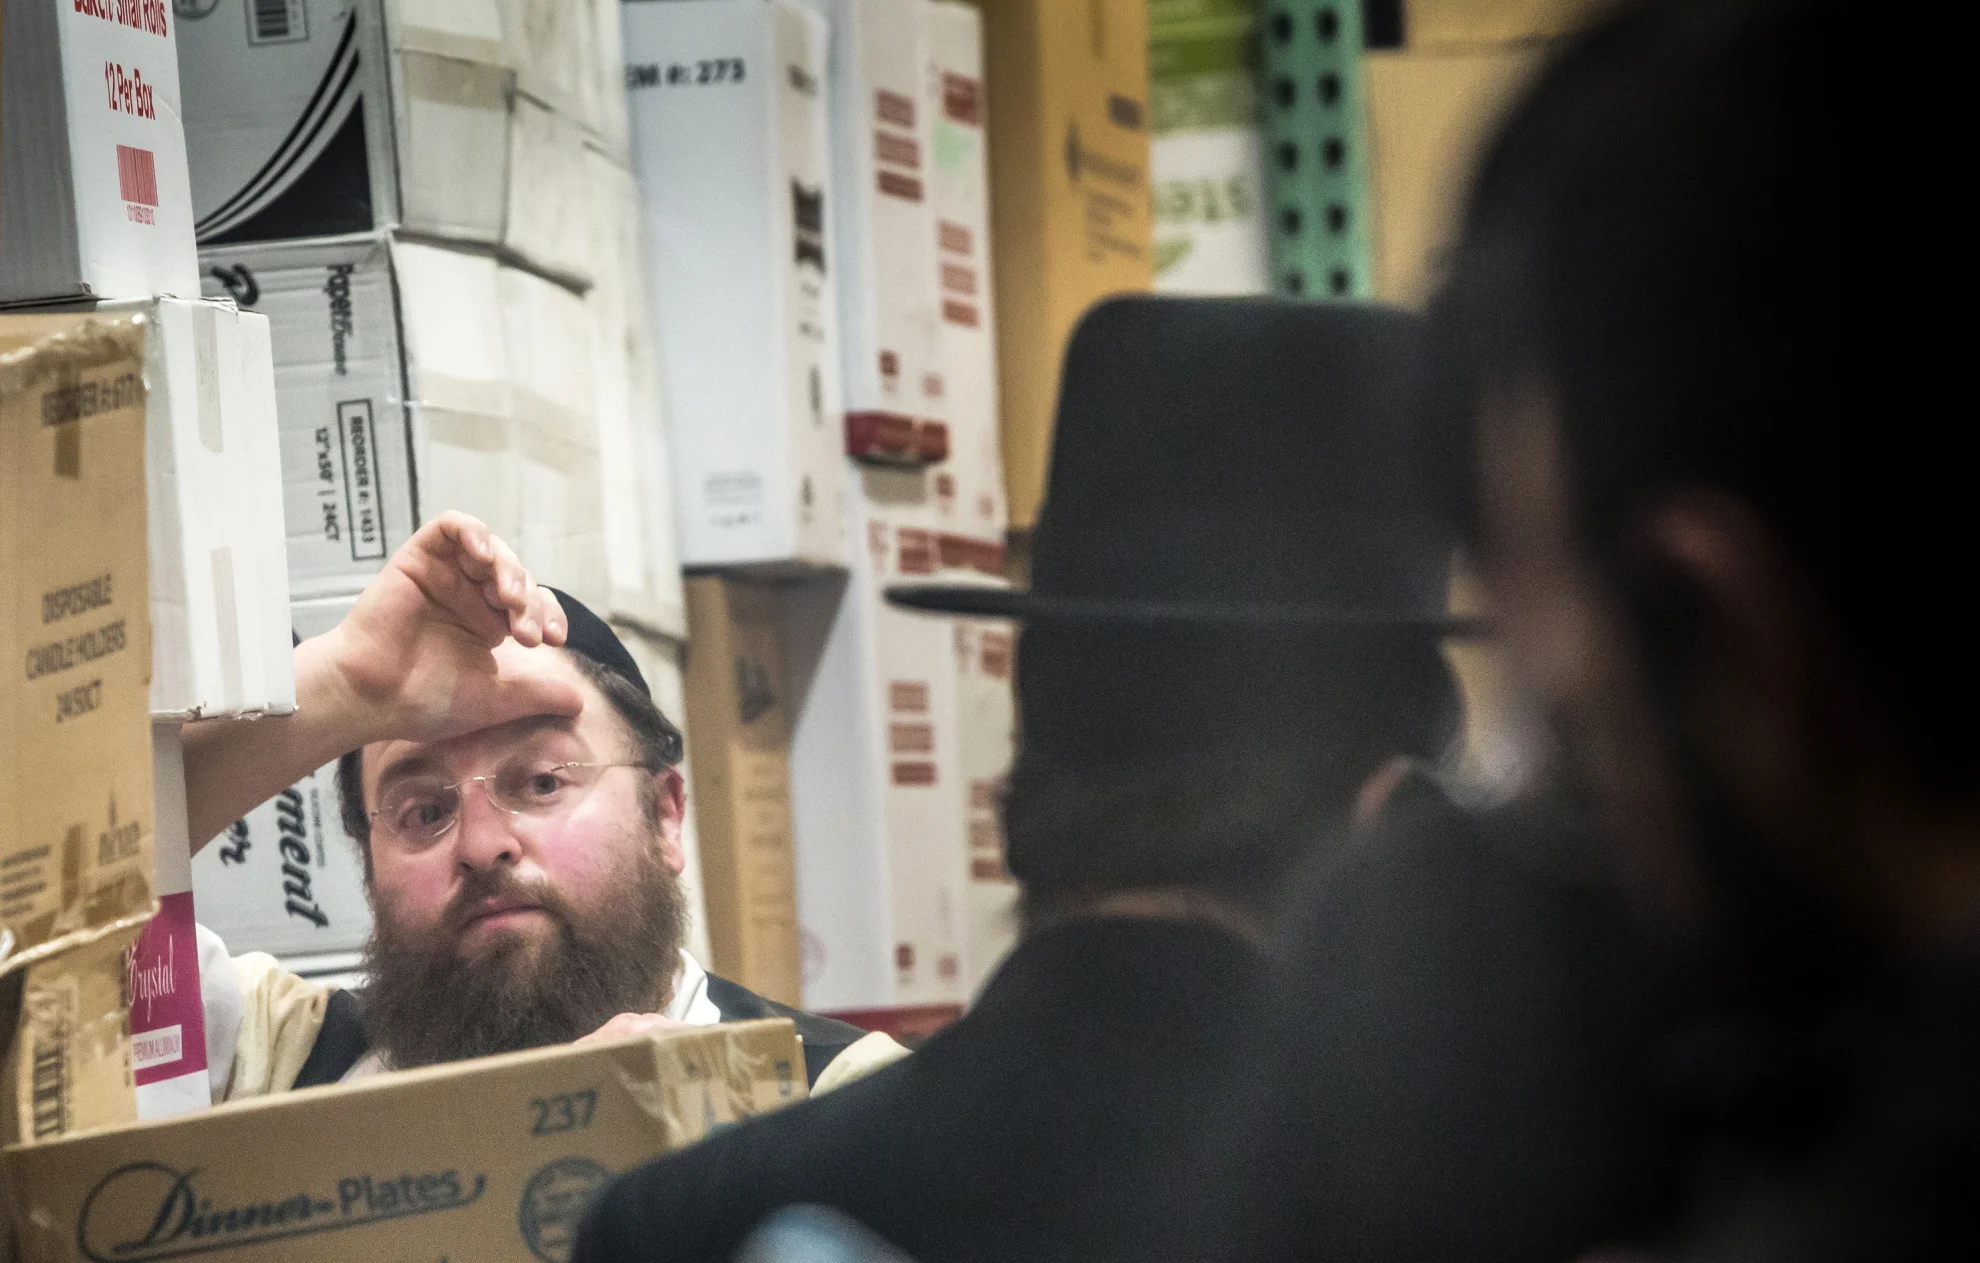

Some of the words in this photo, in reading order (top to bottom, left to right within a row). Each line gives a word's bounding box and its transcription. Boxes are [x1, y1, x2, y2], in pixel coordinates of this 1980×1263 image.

[143, 0, 167, 38] Rolls
[104, 61, 117, 110] 12
[116, 64, 133, 115] Per
[134, 69, 155, 120] Box
[697, 57, 745, 85] 273
[350, 416, 370, 486] REORDER
[26, 636, 74, 681] CANDLE
[275, 788, 329, 928] ment
[127, 934, 176, 1025] Crystal
[528, 1088, 598, 1137] 237
